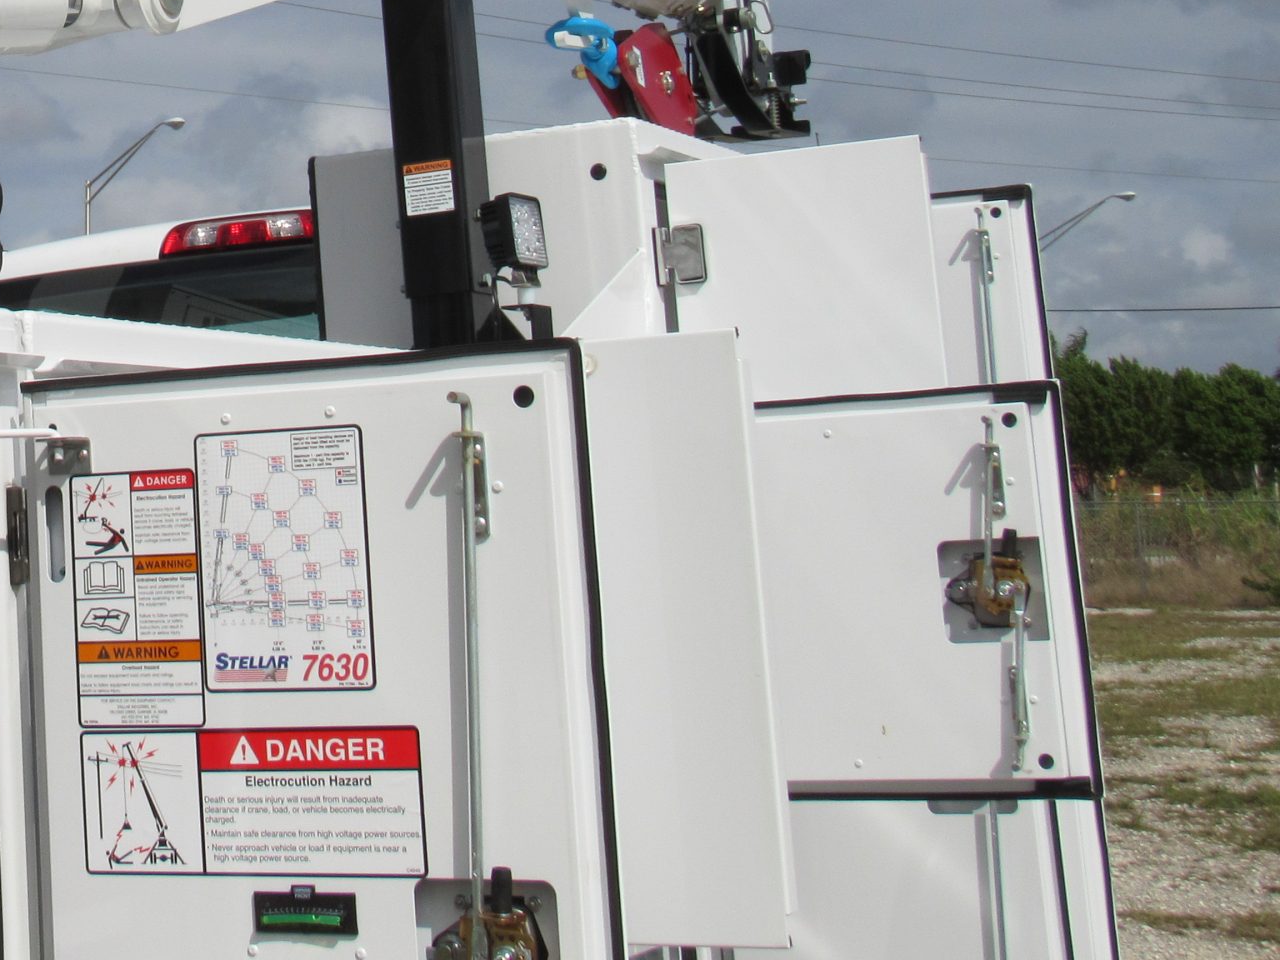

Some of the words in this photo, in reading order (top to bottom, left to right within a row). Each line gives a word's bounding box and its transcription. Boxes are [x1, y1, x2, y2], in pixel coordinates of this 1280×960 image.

[414, 161, 448, 172] WARNING
[146, 475, 187, 486] DANGER
[145, 559, 193, 569] WARNING
[113, 646, 180, 659] WARNING
[215, 652, 289, 670] STELLAR
[302, 652, 369, 682] 7630
[265, 738, 385, 762] DANGER
[245, 775, 325, 787] Electrocution
[329, 775, 372, 787] Hazard
[204, 795, 225, 804] Death
[236, 796, 263, 804] serious
[265, 796, 284, 805] injury
[287, 796, 299, 804] will
[300, 796, 321, 804] result
[322, 796, 340, 804] from
[341, 796, 384, 805] inadequate
[204, 805, 239, 813] clearance
[302, 805, 328, 813] vehicle
[330, 805, 364, 813] becomes
[366, 805, 406, 815] electrically
[205, 815, 235, 825] charged.
[211, 829, 241, 838] Maintain
[243, 829, 259, 838] safe
[260, 829, 296, 838] clearance
[298, 829, 315, 838] from
[317, 829, 334, 839] high
[335, 829, 363, 839] voltage
[364, 830, 388, 839] power
[212, 844, 233, 852] Never
[235, 844, 269, 854] approach
[270, 844, 297, 852] vehicle
[308, 844, 324, 853] load
[332, 845, 373, 854] equipment
[374, 845, 381, 853] is
[213, 853, 230, 863] high
[231, 853, 259, 863] voltage
[260, 854, 282, 863] power
